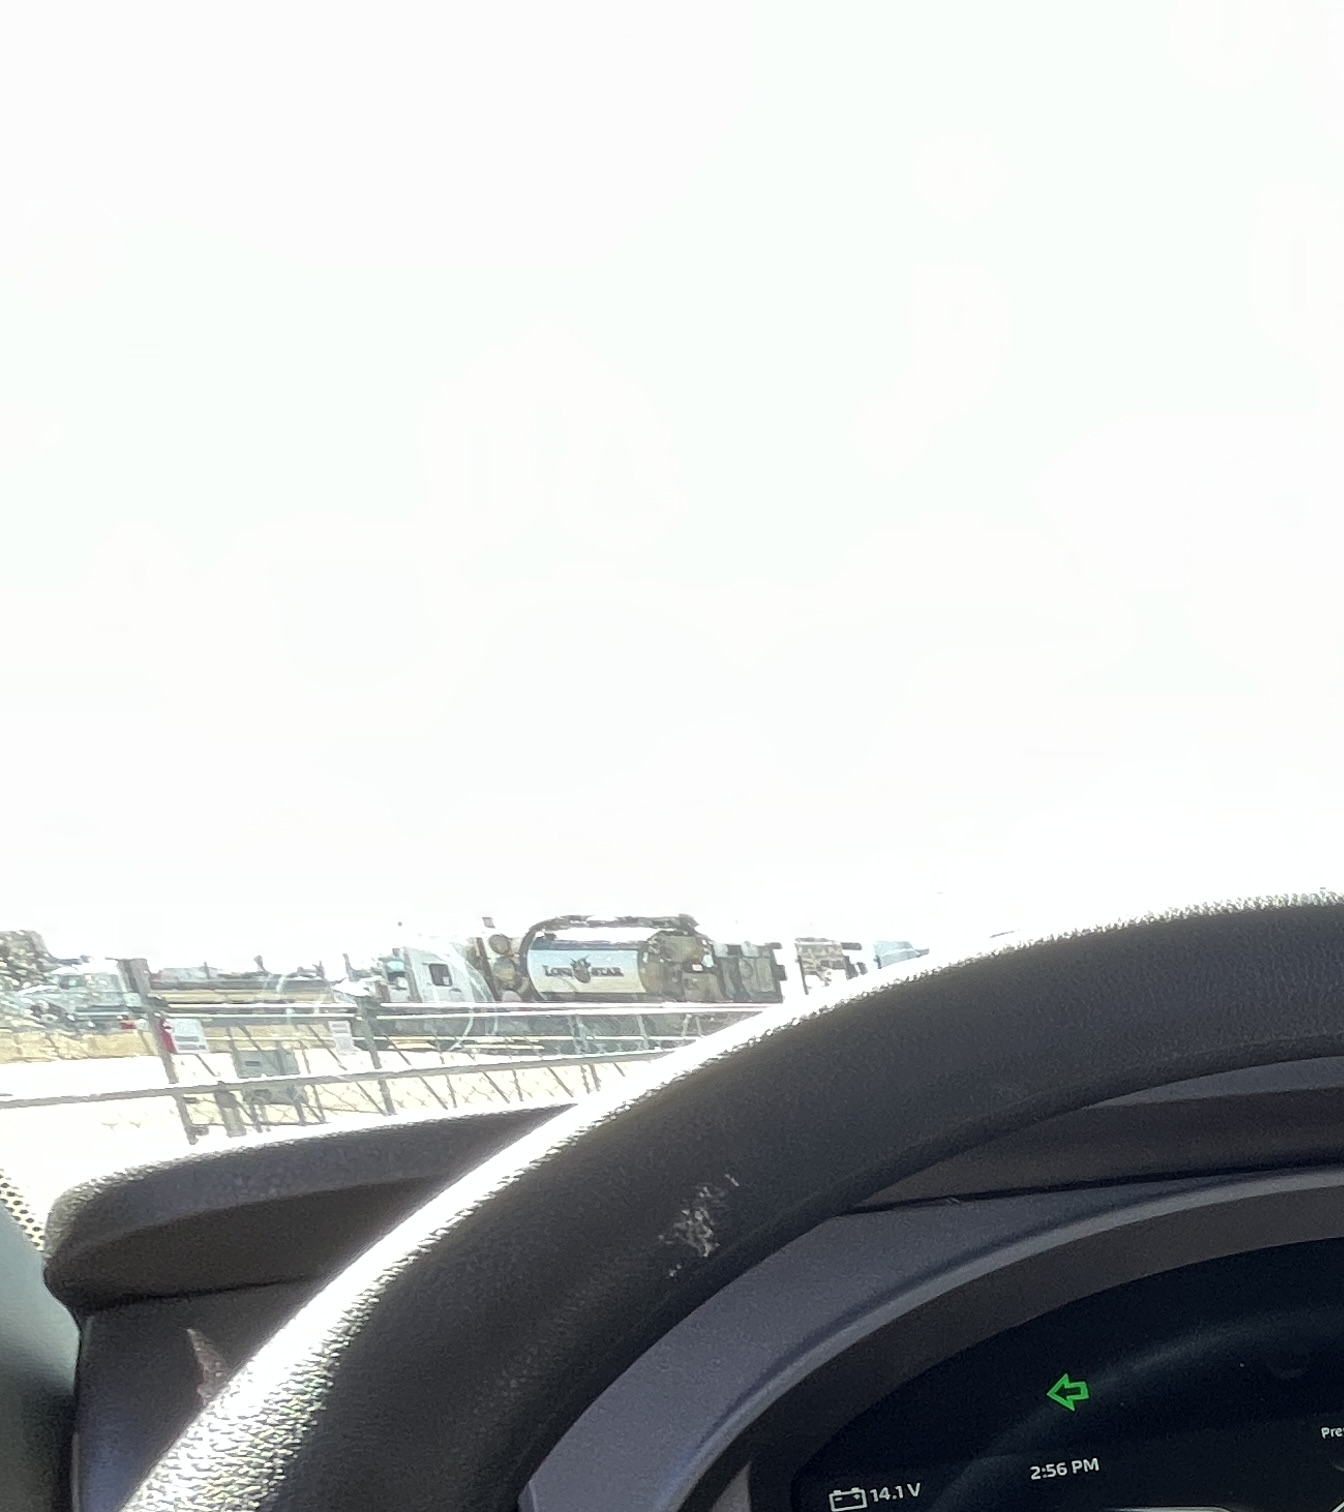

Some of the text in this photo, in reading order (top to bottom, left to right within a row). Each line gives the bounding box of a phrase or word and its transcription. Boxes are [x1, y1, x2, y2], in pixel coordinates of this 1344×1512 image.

[1029, 1457, 1101, 1481] 2:56 PM
[869, 1482, 922, 1503] 14.1 V
